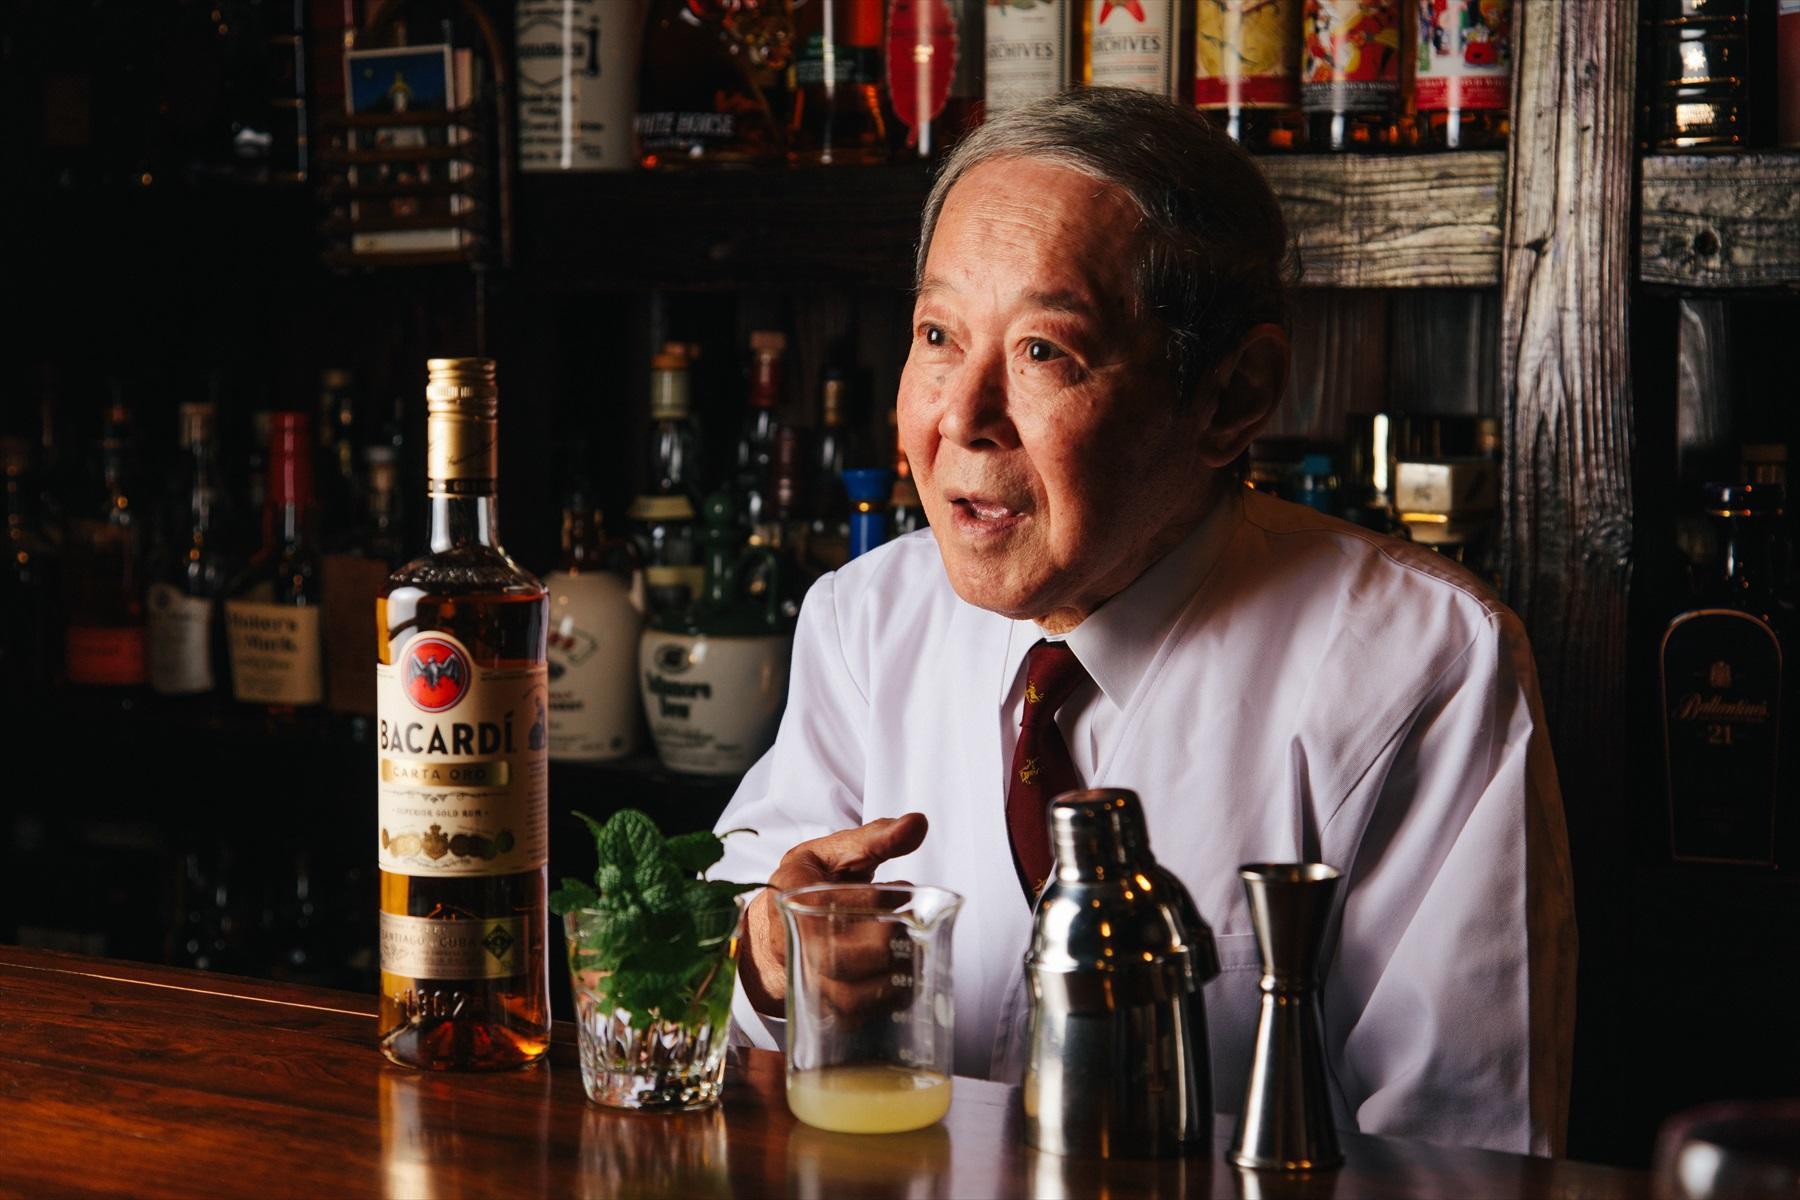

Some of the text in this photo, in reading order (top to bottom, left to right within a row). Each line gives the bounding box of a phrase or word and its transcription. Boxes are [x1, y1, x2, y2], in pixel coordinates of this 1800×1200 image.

[380, 709, 514, 755] BACARDÍ
[1707, 723, 1734, 744] 21
[393, 767, 487, 780] CARTA ORO
[397, 808, 432, 816] SUPERIOR
